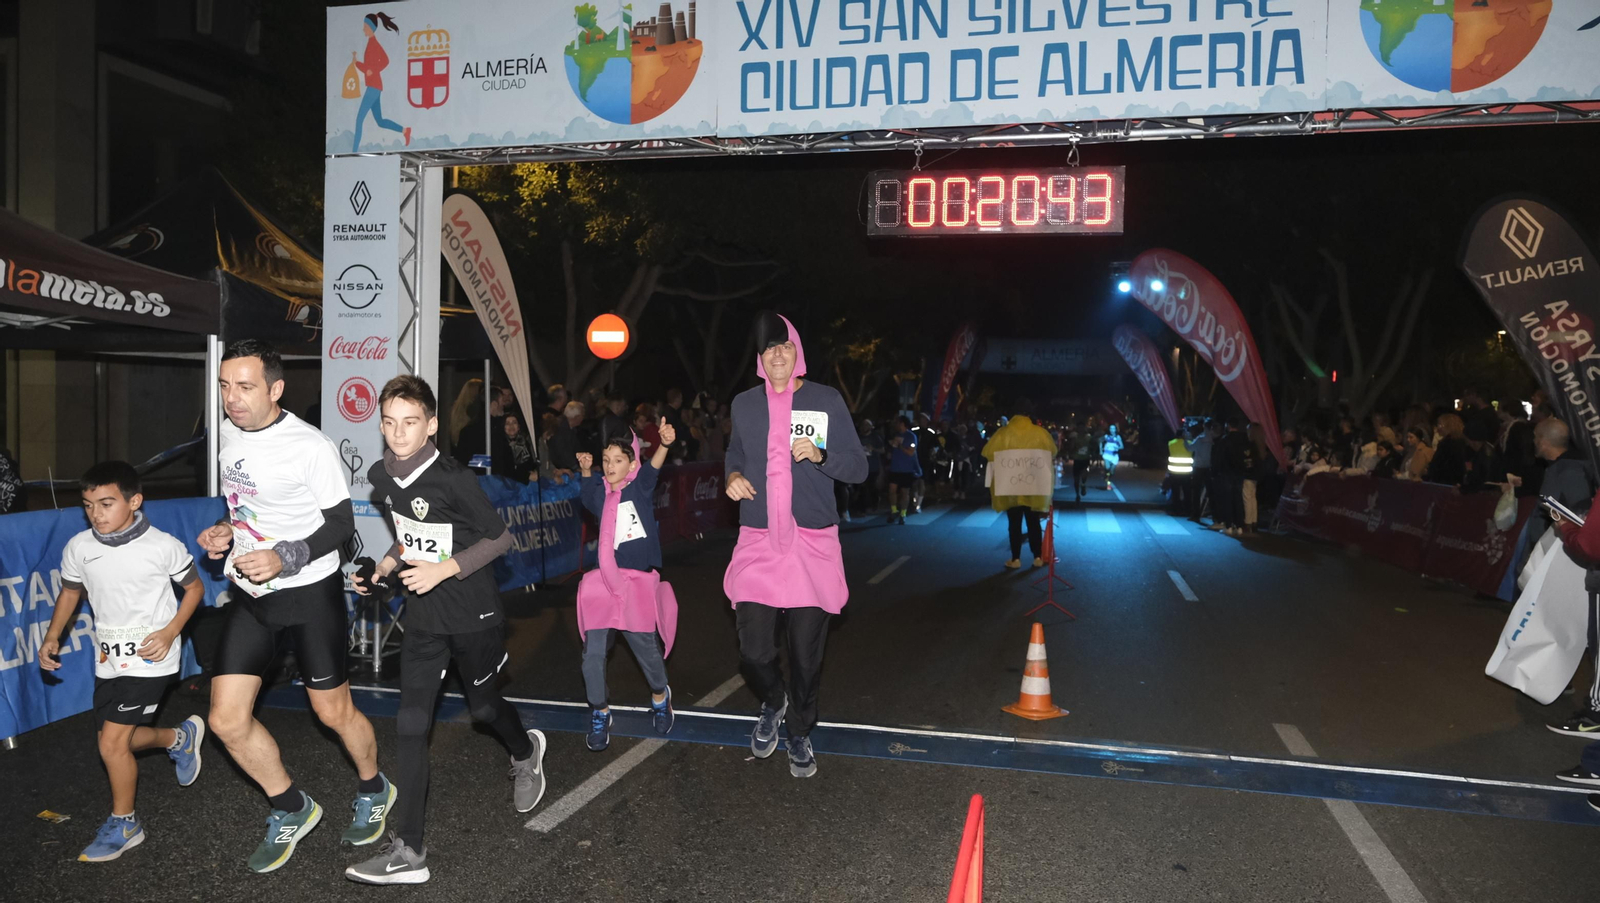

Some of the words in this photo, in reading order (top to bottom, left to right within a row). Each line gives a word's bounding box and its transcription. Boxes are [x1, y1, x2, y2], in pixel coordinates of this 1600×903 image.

[736, 0, 821, 51] XIV
[838, 0, 949, 45] SAN
[461, 54, 548, 80] ALMERÍA
[740, 51, 930, 113] CIUDAD
[949, 45, 1020, 102] DE
[1037, 18, 1305, 97] ALMERÍA
[481, 77, 526, 92] CIUDAD
[332, 223, 387, 233] RENAULT
[0, 258, 171, 317] lameta.es
[332, 283, 384, 291] NISSAN
[337, 311, 382, 319] andalmotor.es
[328, 335, 392, 360] Coca-Cola
[234, 458, 245, 470] 6
[350, 455, 370, 488] Paqu
[225, 466, 251, 480] Horas
[1010, 473, 1036, 486] ORO
[237, 484, 259, 497] Stop
[403, 532, 438, 553] 912
[100, 641, 137, 657] 913
